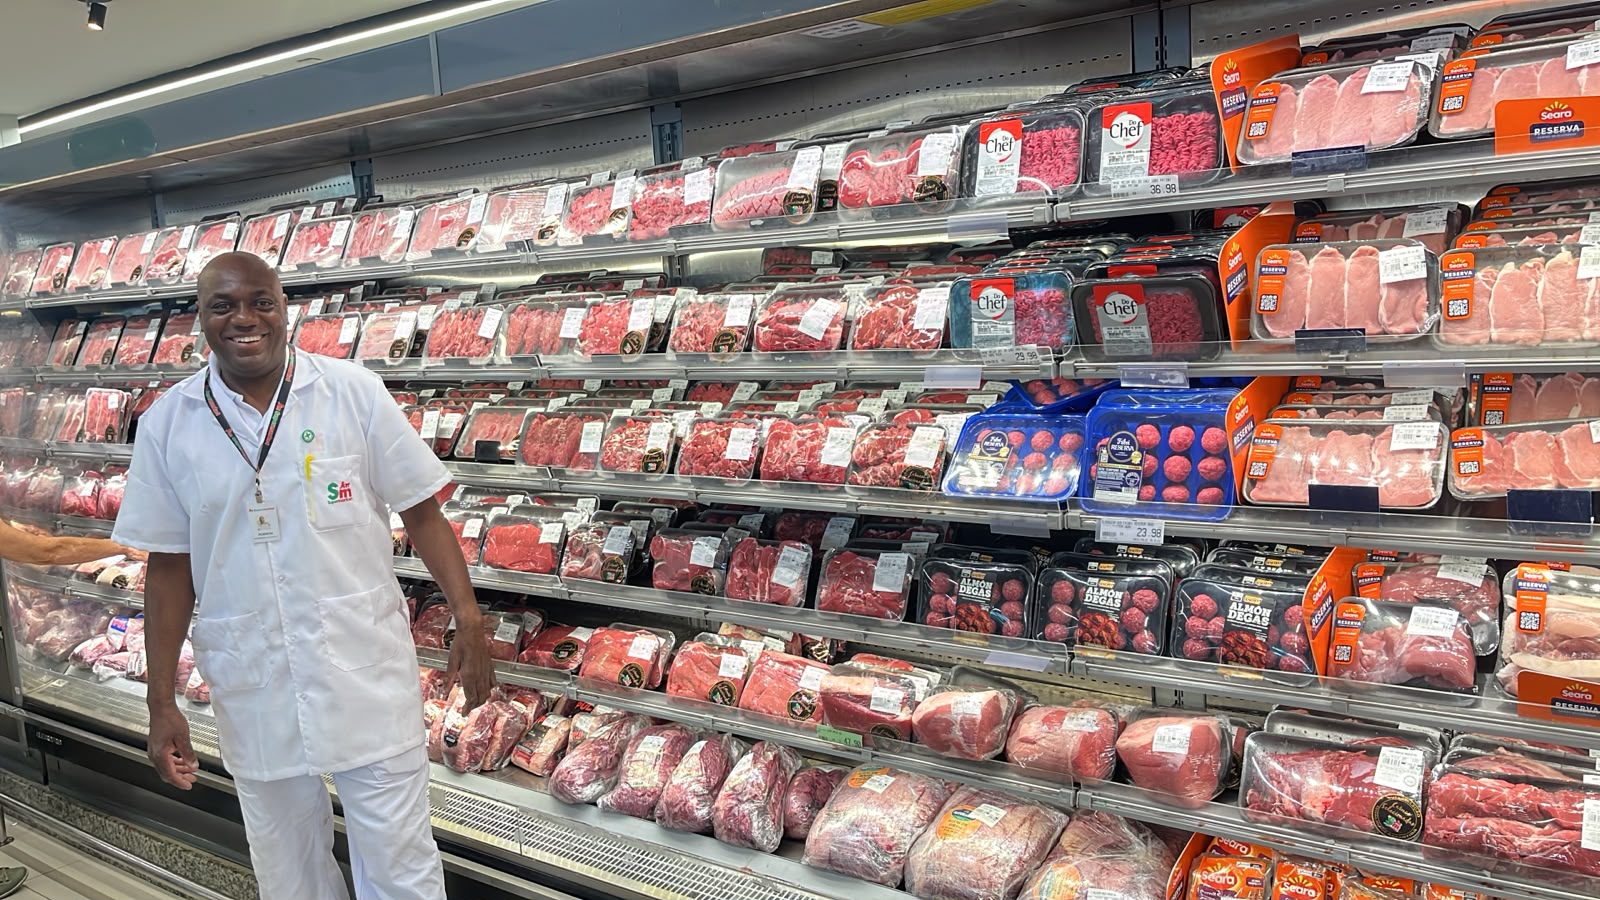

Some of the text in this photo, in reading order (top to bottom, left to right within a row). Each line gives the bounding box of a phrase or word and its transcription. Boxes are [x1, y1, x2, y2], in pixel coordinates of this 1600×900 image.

[1223, 72, 1240, 85] Seara
[1443, 72, 1472, 80] RESERVA
[1222, 92, 1246, 108] RESERVA
[1541, 110, 1572, 121] Seara
[1109, 121, 1144, 138] Chef
[1533, 124, 1580, 136] RESERVA
[986, 137, 1015, 153] Chef
[1150, 184, 1176, 194] 36.98
[1228, 252, 1243, 270] Seara
[1226, 269, 1247, 293] RESERVA
[977, 294, 1008, 310] Chef
[1103, 300, 1138, 315] Chef
[1234, 405, 1249, 423] Seara
[1233, 420, 1254, 446] RESERVA
[1136, 527, 1162, 538] 23.98
[958, 585, 992, 598] DEGAS
[1312, 581, 1327, 605] Seara
[1083, 594, 1122, 608] DEGAS
[1226, 609, 1270, 627] DEGAS
[1311, 595, 1333, 629] RESERVA
[1562, 689, 1592, 700] Seara
[1555, 701, 1599, 713] RESERVA
[1218, 836, 1248, 855] Seara
[1201, 870, 1235, 885] Seara
[1283, 881, 1316, 898] Seara
